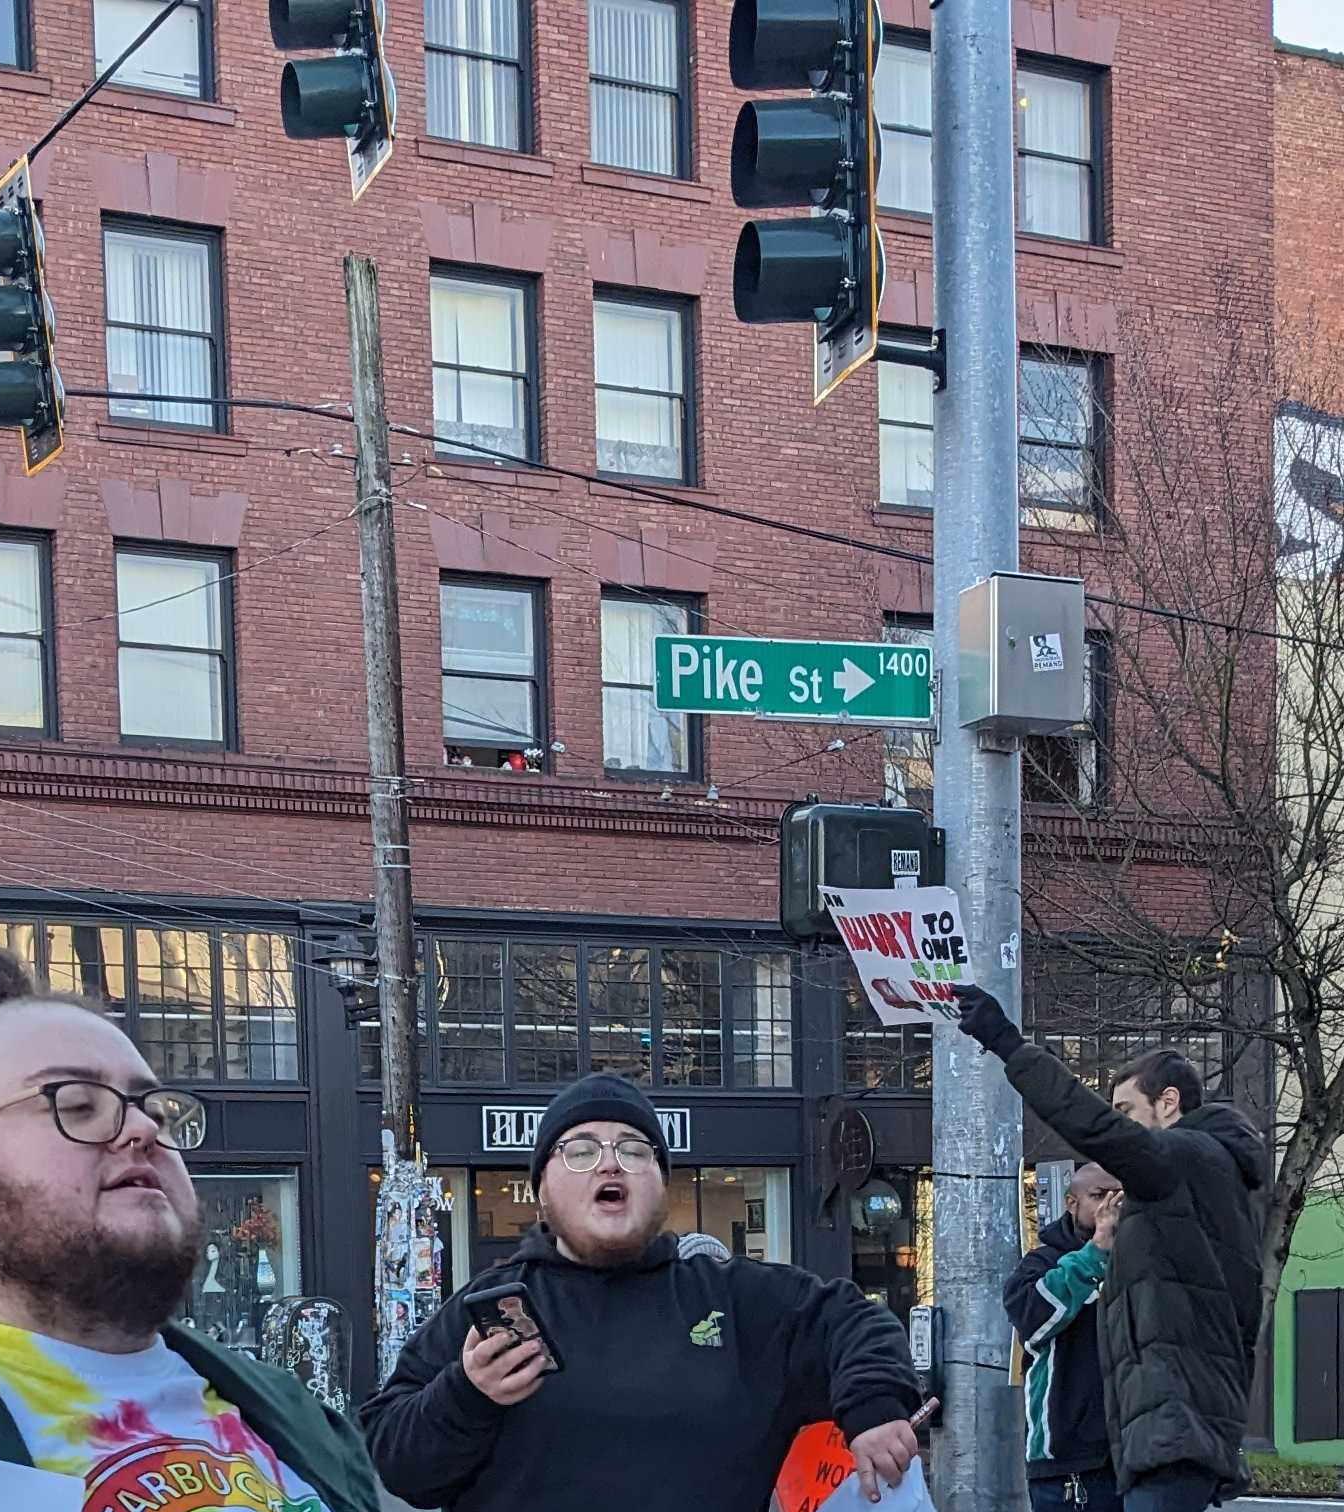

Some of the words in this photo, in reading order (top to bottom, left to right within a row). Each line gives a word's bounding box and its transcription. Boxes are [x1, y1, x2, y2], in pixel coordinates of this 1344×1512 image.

[671, 643, 763, 702] Pike
[789, 665, 823, 704] St
[878, 652, 927, 677] 1400
[823, 892, 845, 908] AN
[837, 911, 921, 960] INJURY
[922, 911, 954, 935] TO
[921, 936, 969, 966] ONE
[909, 979, 960, 1003] INJU
[928, 1002, 961, 1021] TO
[492, 1111, 542, 1146] BLA
[815, 1459, 846, 1487] WO
